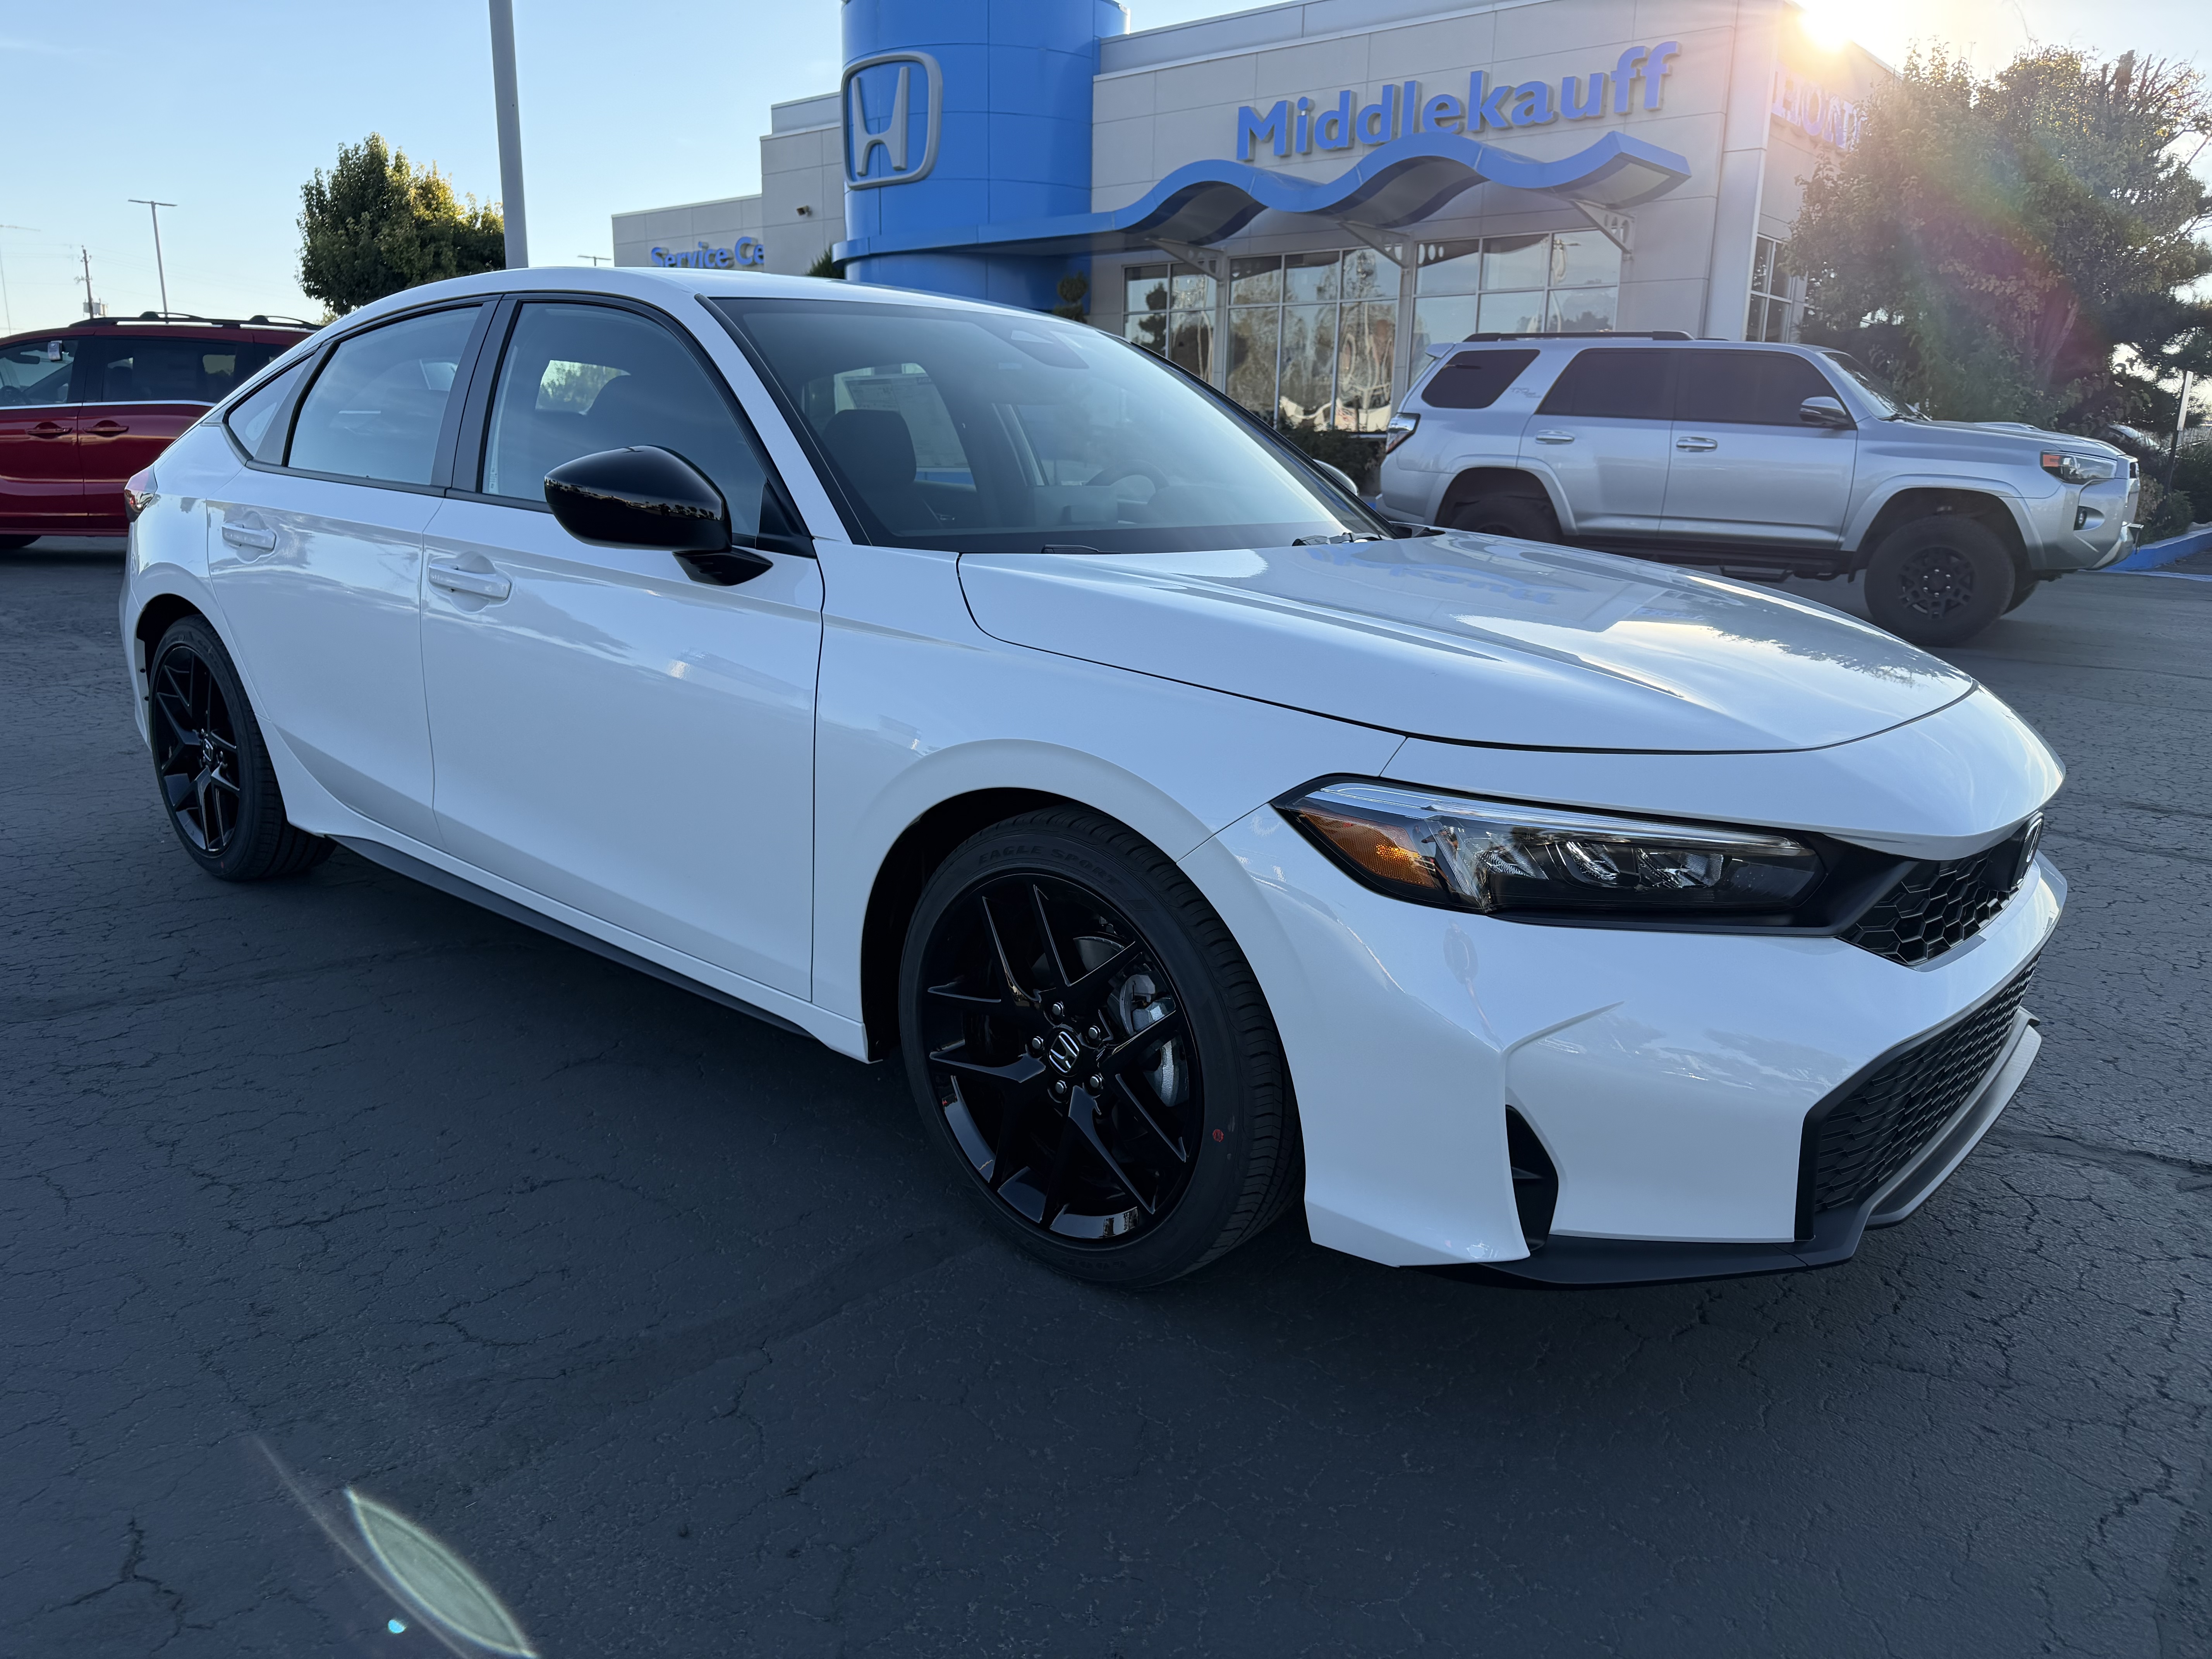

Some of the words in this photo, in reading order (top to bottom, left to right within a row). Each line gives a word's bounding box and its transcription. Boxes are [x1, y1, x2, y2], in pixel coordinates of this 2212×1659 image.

[1237, 40, 1681, 161] Middlekauff
[651, 241, 733, 268] Service
[979, 845, 1045, 865] EAGLE
[1051, 848, 1122, 886] SPORT
